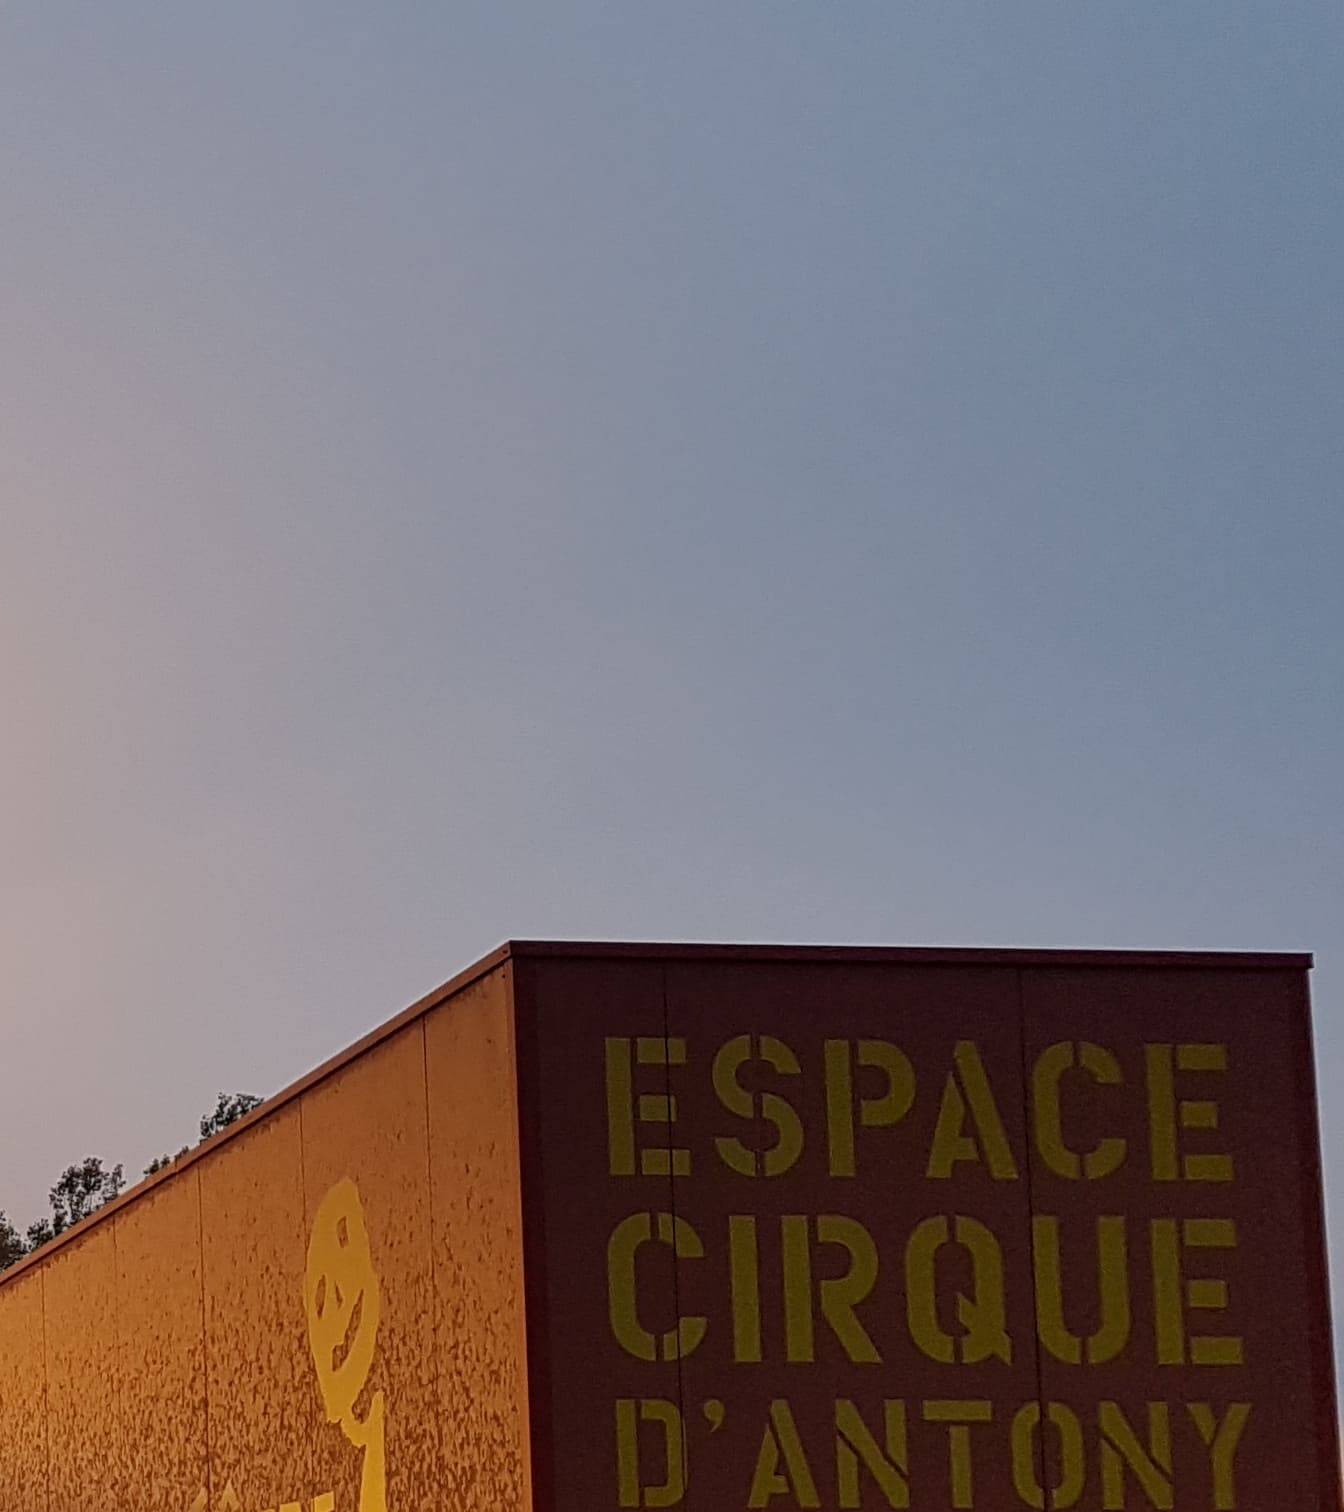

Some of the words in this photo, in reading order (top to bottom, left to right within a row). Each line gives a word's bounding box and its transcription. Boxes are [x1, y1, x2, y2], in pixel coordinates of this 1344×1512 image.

[605, 1034, 1235, 1181] ESPACE
[607, 1211, 1245, 1366] CIRQUE
[616, 1400, 1253, 1512] D'ANTONY
